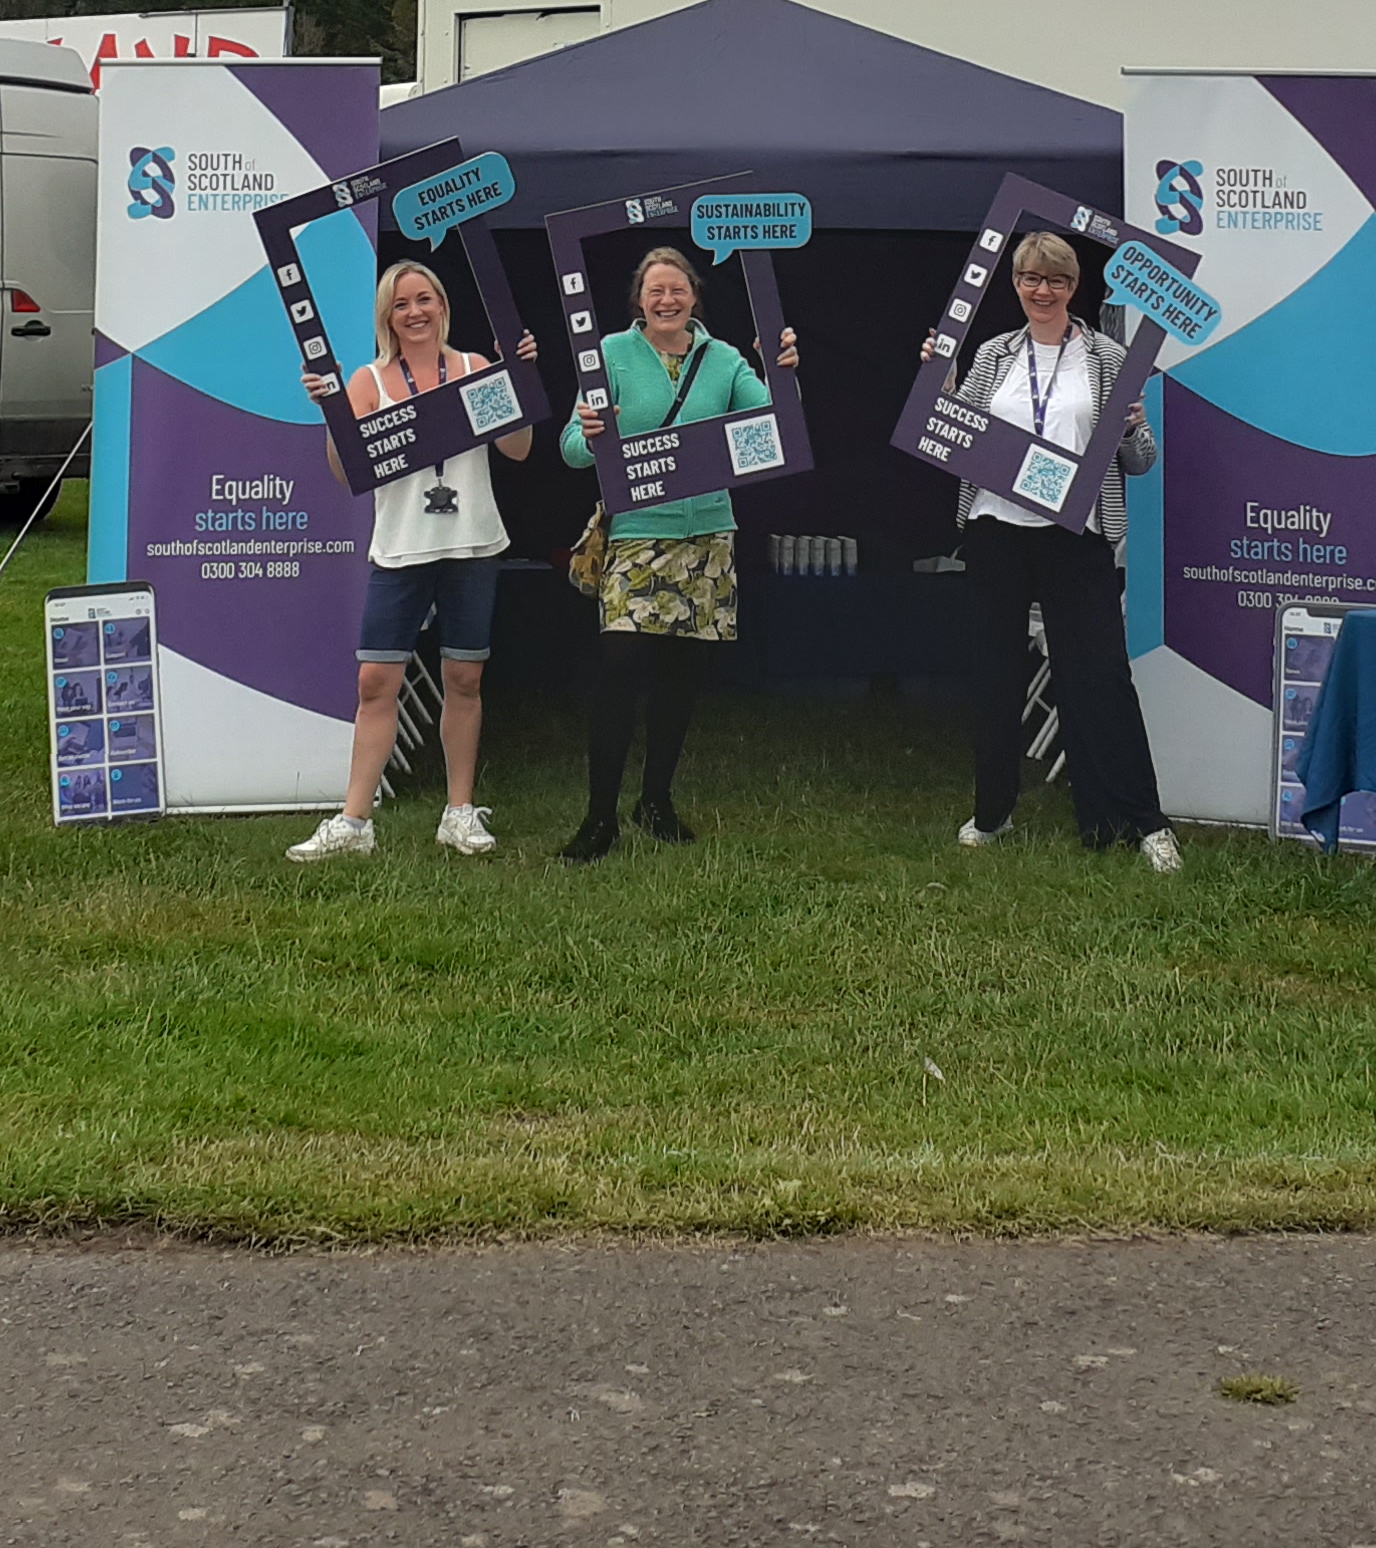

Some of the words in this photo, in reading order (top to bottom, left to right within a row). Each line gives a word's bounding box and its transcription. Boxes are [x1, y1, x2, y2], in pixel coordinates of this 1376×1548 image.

[188, 153, 242, 172] SOUTH
[245, 159, 257, 171] of
[188, 173, 274, 191] SCOTLAND
[418, 167, 481, 206] EQUALITY
[1216, 168, 1273, 188] SOUTH
[1275, 175, 1287, 188] of
[414, 202, 466, 231] STARTS
[466, 182, 502, 209] HERE
[696, 202, 806, 219] SUSTAINABILITY
[1216, 189, 1307, 209] SCOTLAND
[707, 225, 759, 240] STARTS
[762, 224, 797, 239] HERE
[1216, 210, 1324, 232] ENTERPRISE
[1122, 245, 1218, 322] OPPORTUNITY
[1111, 264, 1165, 311] STARTS
[1162, 303, 1203, 340] HERE
[359, 405, 417, 439] SUCCESS
[934, 397, 989, 432] SUCCESS
[367, 428, 416, 458] STARTS
[622, 433, 680, 458] SUCCESS
[926, 417, 973, 449] STARTS
[918, 436, 952, 462] HERE
[374, 454, 408, 479] HERE
[626, 457, 676, 480] STARTS
[211, 474, 294, 505] Equality
[631, 481, 665, 502] HERE
[195, 508, 256, 531] starts
[261, 506, 308, 530] here
[1245, 501, 1331, 538] Equality
[147, 537, 355, 557] southofscotlandenterprise.com
[1230, 536, 1293, 562] starts
[1298, 538, 1348, 565] here
[201, 562, 235, 579] 0300
[238, 562, 263, 578] 304
[266, 561, 300, 578] 8888
[1237, 590, 1272, 608] 0300
